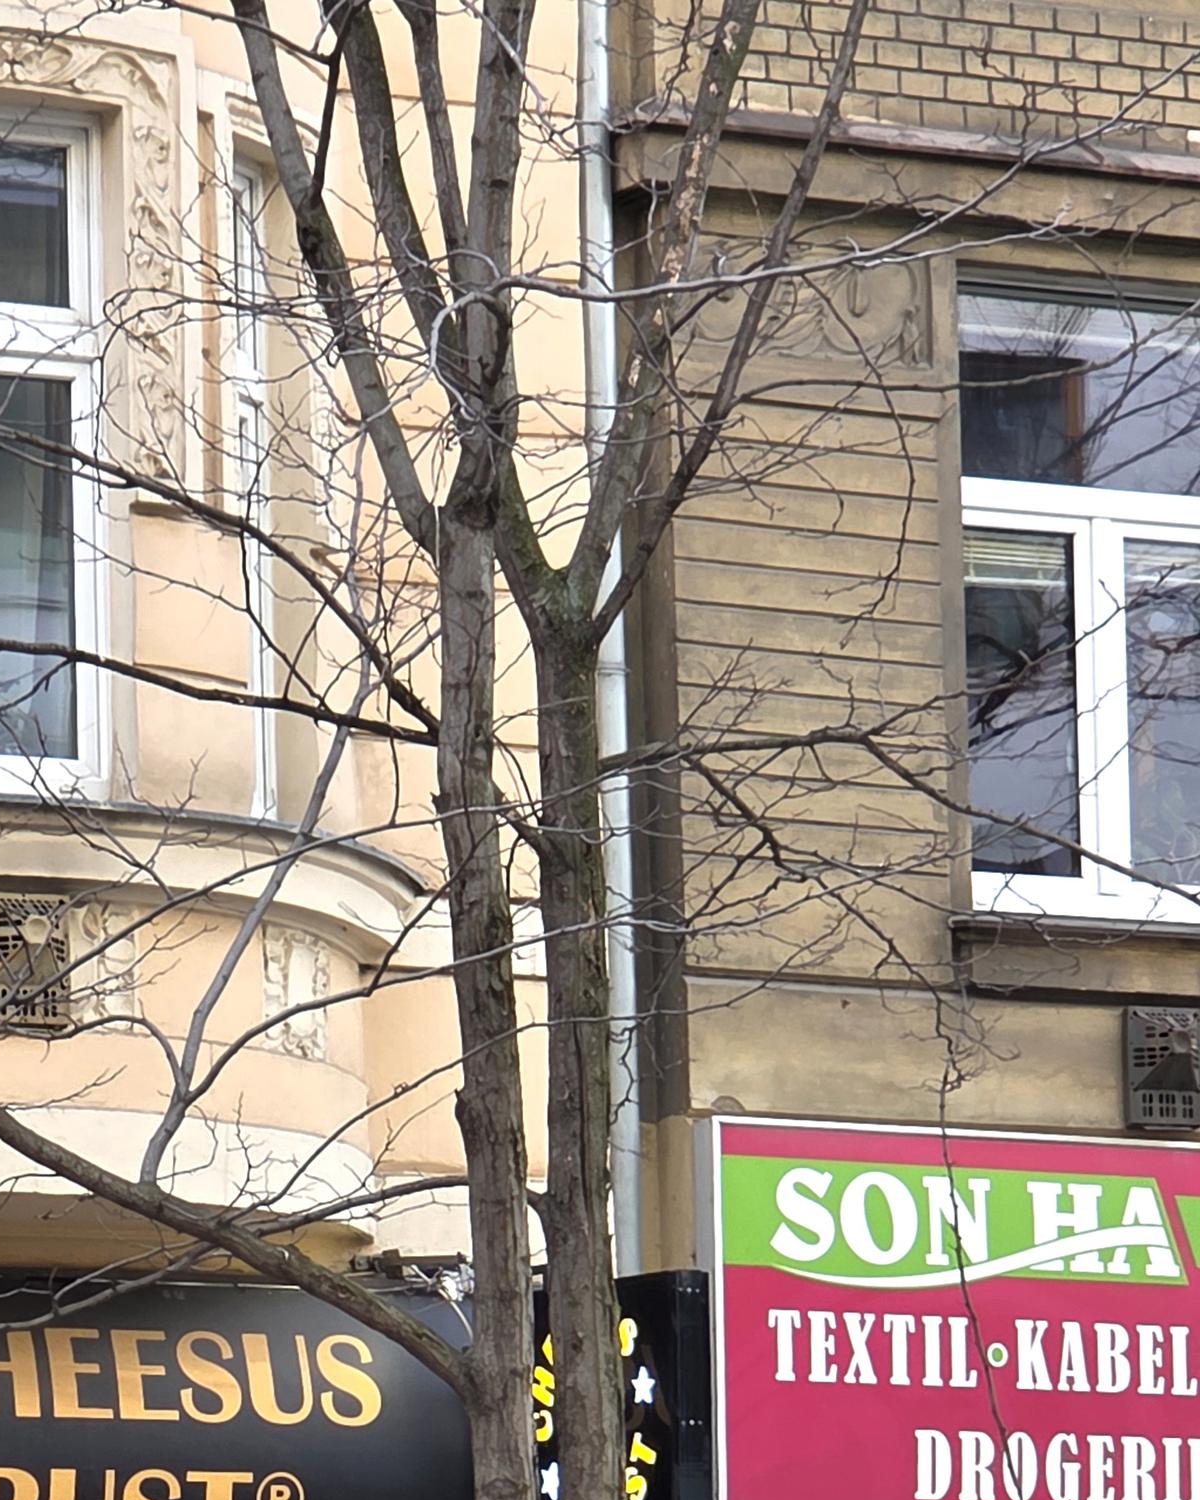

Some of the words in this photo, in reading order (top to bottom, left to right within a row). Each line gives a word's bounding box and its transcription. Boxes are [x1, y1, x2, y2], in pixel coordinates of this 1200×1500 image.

[770, 1167, 991, 1266] SON
[1026, 1180, 1181, 1278] HA
[768, 1308, 978, 1388] TEXTIL
[1015, 1318, 1199, 1397] KABEL
